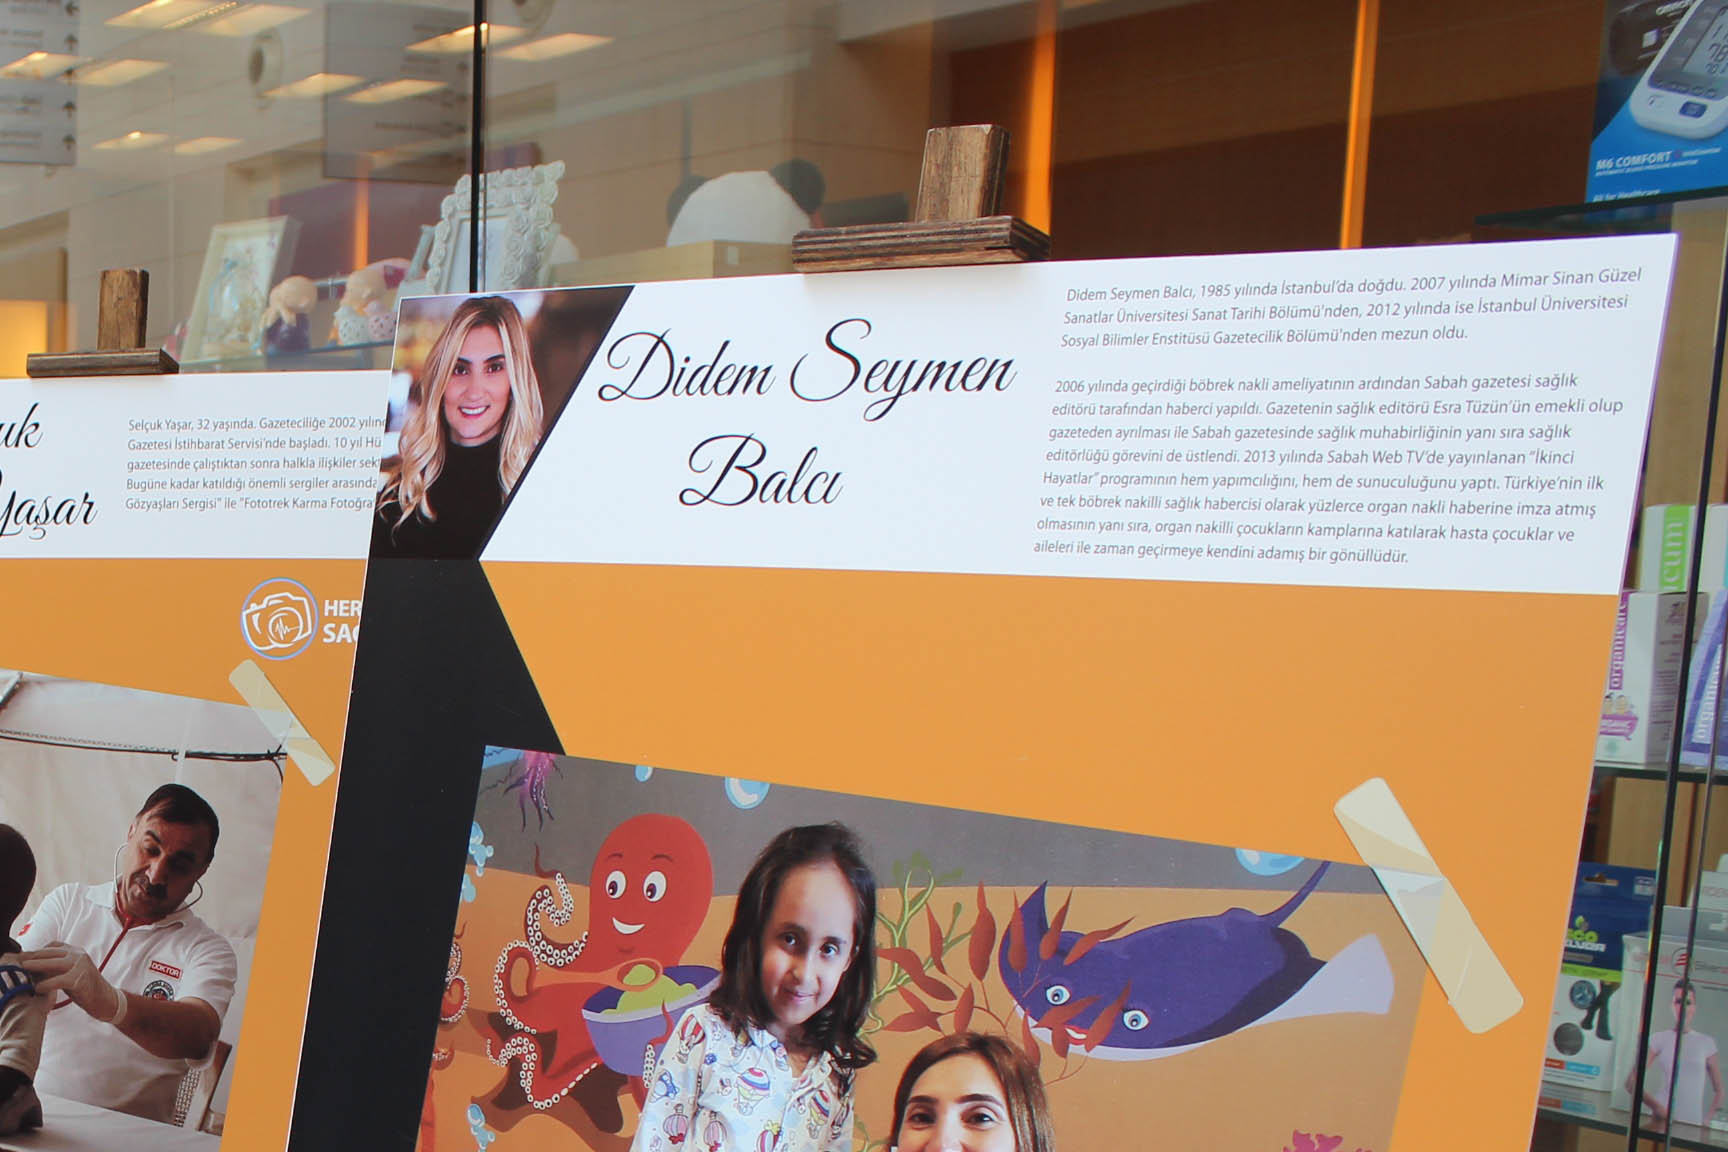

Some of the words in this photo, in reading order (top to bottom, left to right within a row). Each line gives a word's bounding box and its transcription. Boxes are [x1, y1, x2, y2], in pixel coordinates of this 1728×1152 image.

[1616, 151, 1672, 167] COMFORT
[1060, 333, 1100, 350] Sosyal
[1101, 332, 1150, 346] Bilimler
[1151, 331, 1210, 345] Enstitüsü
[1212, 329, 1283, 344] Gazetecilik
[1380, 329, 1428, 341] mezun
[1432, 324, 1468, 340] oldu.
[598, 329, 776, 402] Didem
[790, 317, 1018, 422] Seymen
[1054, 379, 1085, 393] 2006
[1087, 379, 1128, 396] yılında
[1131, 378, 1186, 396] geçirdiği
[1188, 377, 1235, 392] böbrek
[1237, 377, 1269, 391] nakli
[1271, 376, 1355, 394] ameliyatının
[1357, 375, 1420, 390] ardından
[1423, 375, 1468, 390] Sabah
[1471, 374, 1532, 392] gazetesi
[1534, 372, 1578, 391] sağlık
[127, 457, 191, 473] gazetesinde
[192, 456, 248, 472] çalıştıktan
[249, 459, 280, 469] sonra
[282, 456, 315, 469] halkla
[318, 455, 357, 472] ilişkiler
[359, 455, 377, 468] sek
[679, 433, 844, 506] Balcı
[126, 478, 168, 493] Bugüne
[169, 477, 200, 490] kadar
[202, 476, 246, 492] katıldığı
[247, 476, 286, 489] önemli
[288, 476, 330, 492] sergiler
[1036, 517, 1096, 531] olmasının
[1098, 521, 1124, 534] yanı
[1127, 521, 1151, 534] sıra,
[1154, 522, 1192, 536] organ
[1194, 520, 1234, 534] nakilli
[1236, 521, 1304, 538] çocukların
[1306, 522, 1383, 540] kamplarına
[1386, 523, 1447, 539] katılarak
[1449, 524, 1488, 540] hasta
[1491, 526, 1554, 544] çocuklar
[1557, 530, 1575, 542] ve
[152, 962, 179, 976] DOKTOR
